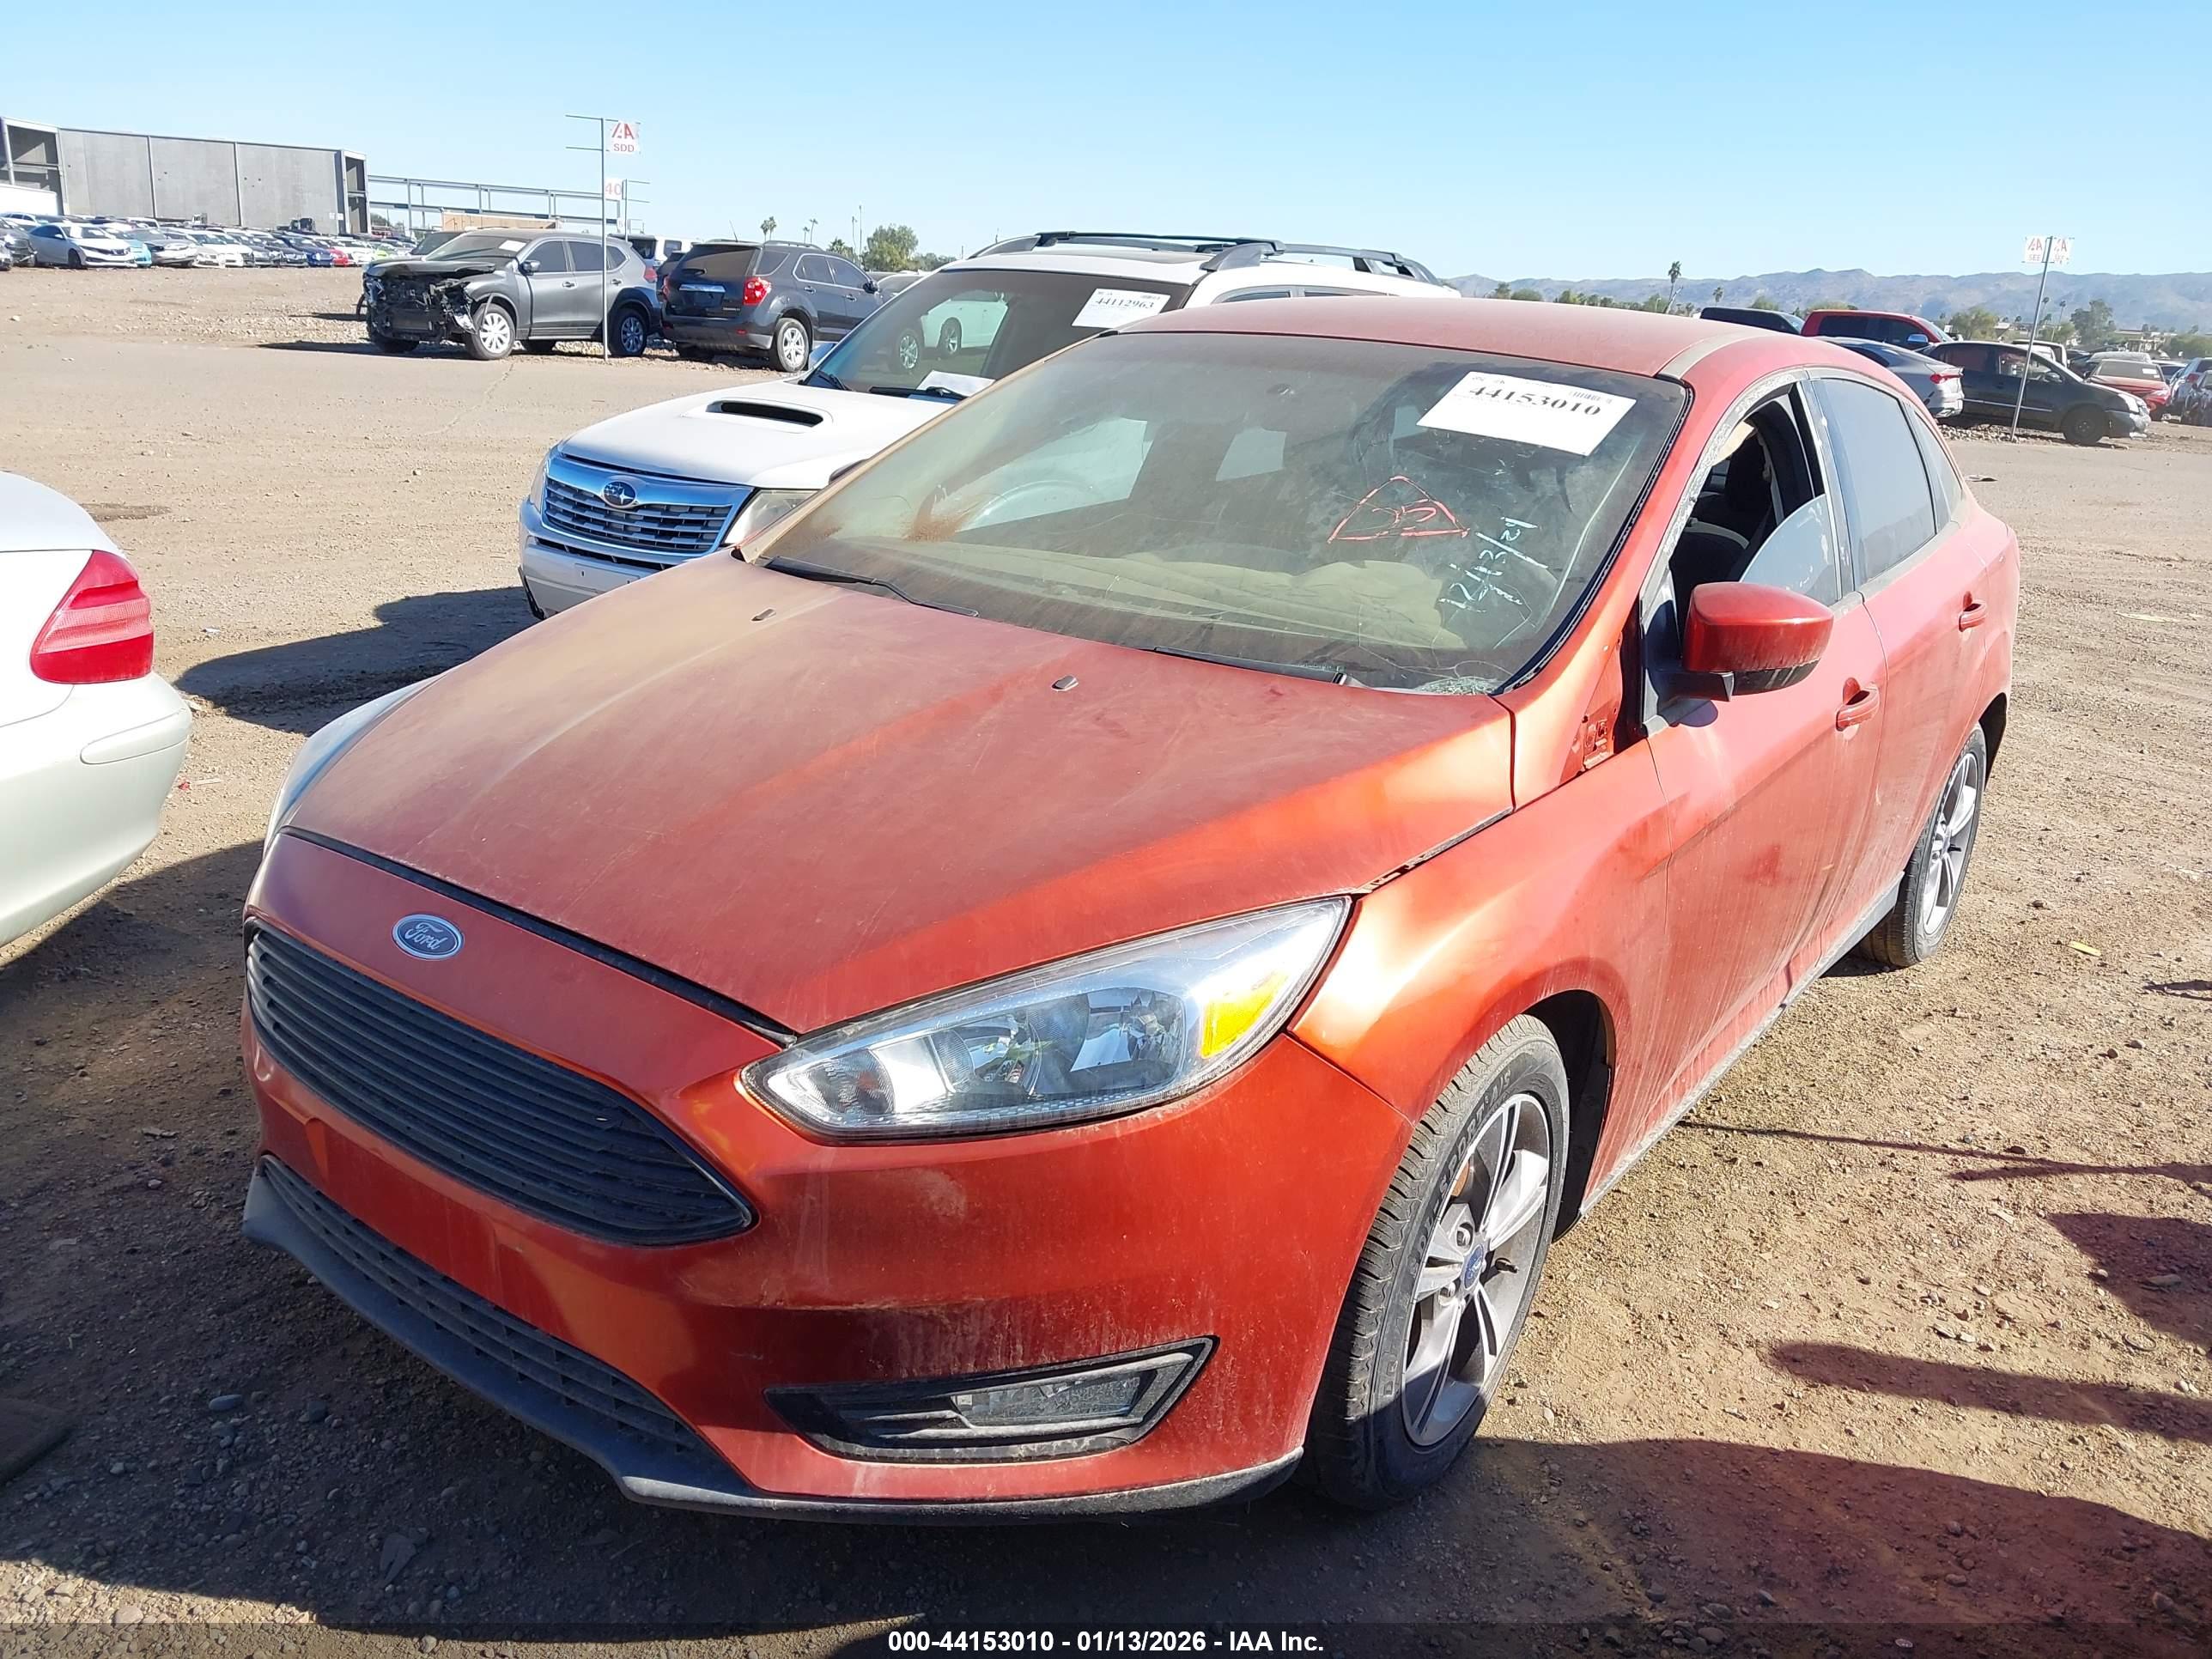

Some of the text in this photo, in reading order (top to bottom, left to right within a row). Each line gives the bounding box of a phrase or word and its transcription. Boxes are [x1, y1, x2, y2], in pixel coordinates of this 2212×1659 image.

[613, 143, 635, 153] SDD
[1095, 297, 1155, 309] 44112963
[1468, 386, 1601, 416] 44153010
[404, 921, 448, 950] Ford
